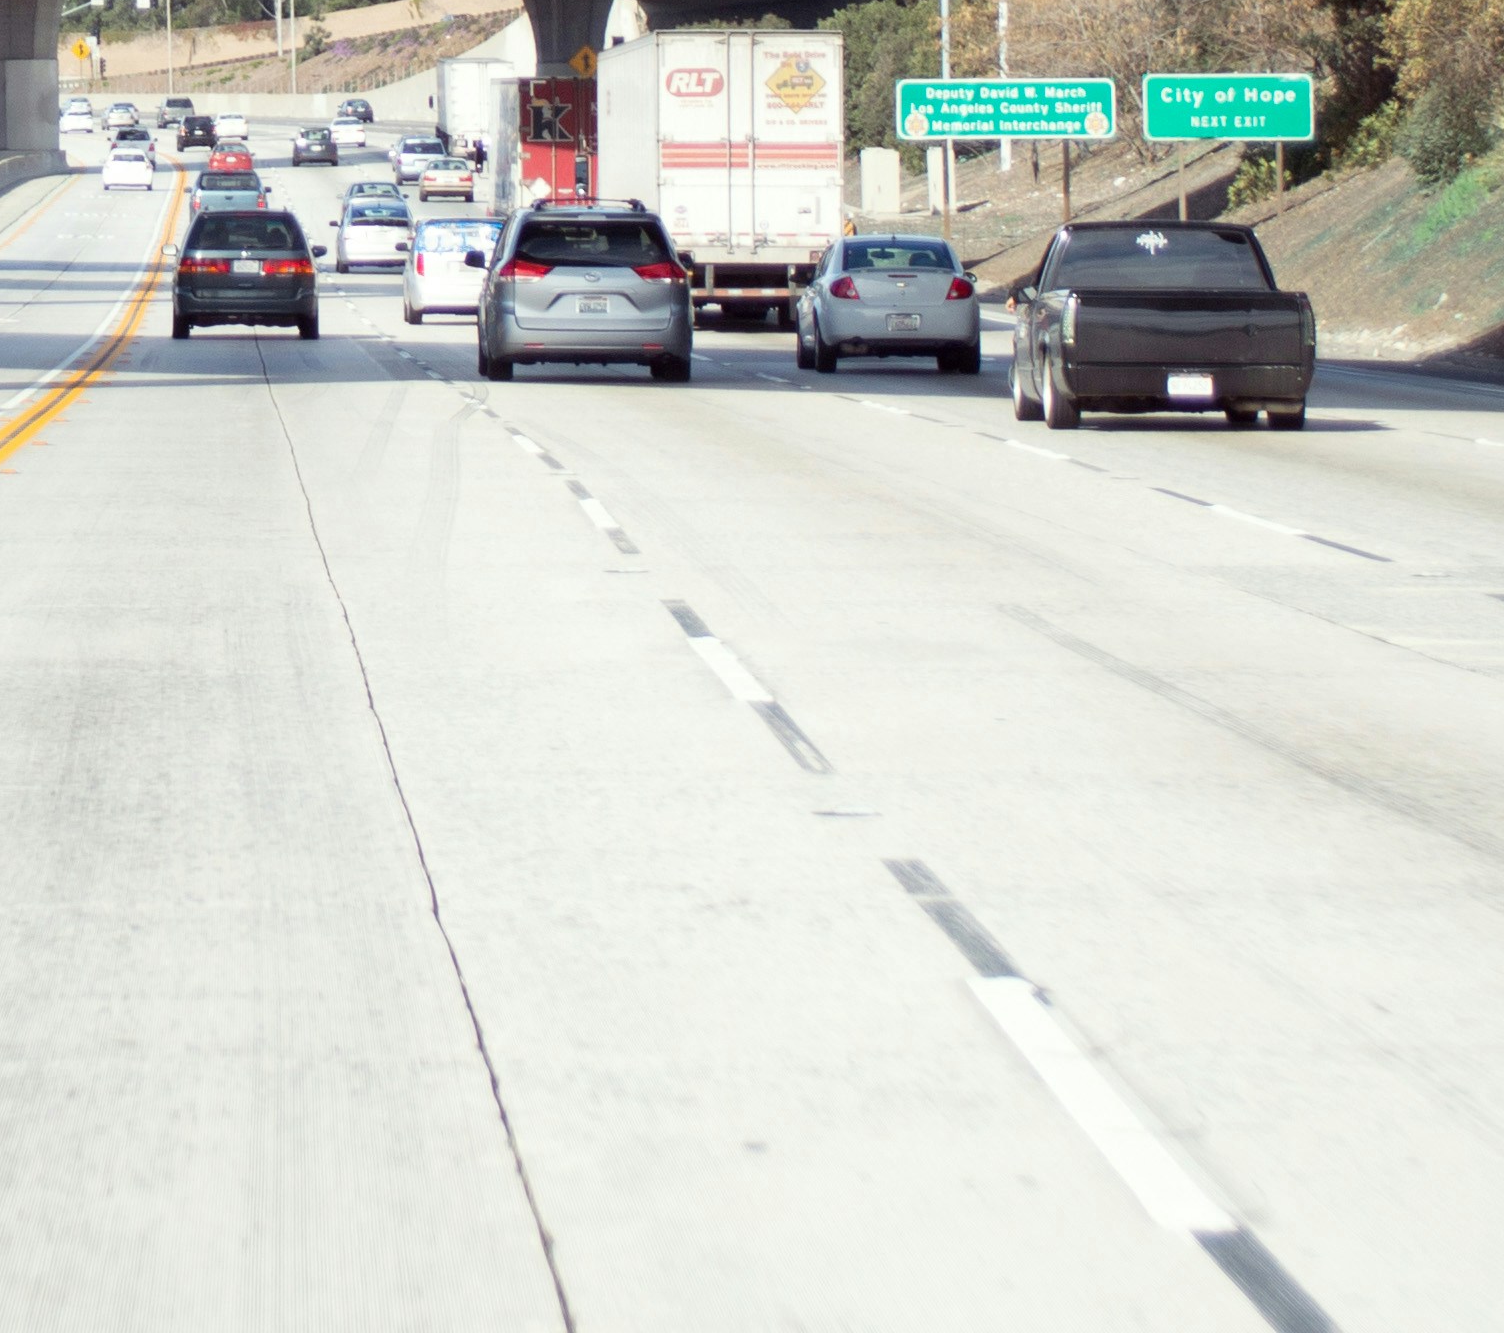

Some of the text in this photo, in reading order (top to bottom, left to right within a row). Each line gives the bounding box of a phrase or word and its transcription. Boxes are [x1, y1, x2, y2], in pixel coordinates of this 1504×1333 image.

[669, 72, 721, 94] RLT
[926, 87, 1086, 100] Deputy David W. March
[1161, 87, 1296, 108] City of Hope
[911, 102, 1103, 116] Los Angeles County Sheriff
[932, 120, 1082, 133] Memorial Interchange
[1190, 115, 1267, 128] NEXT EXIT
